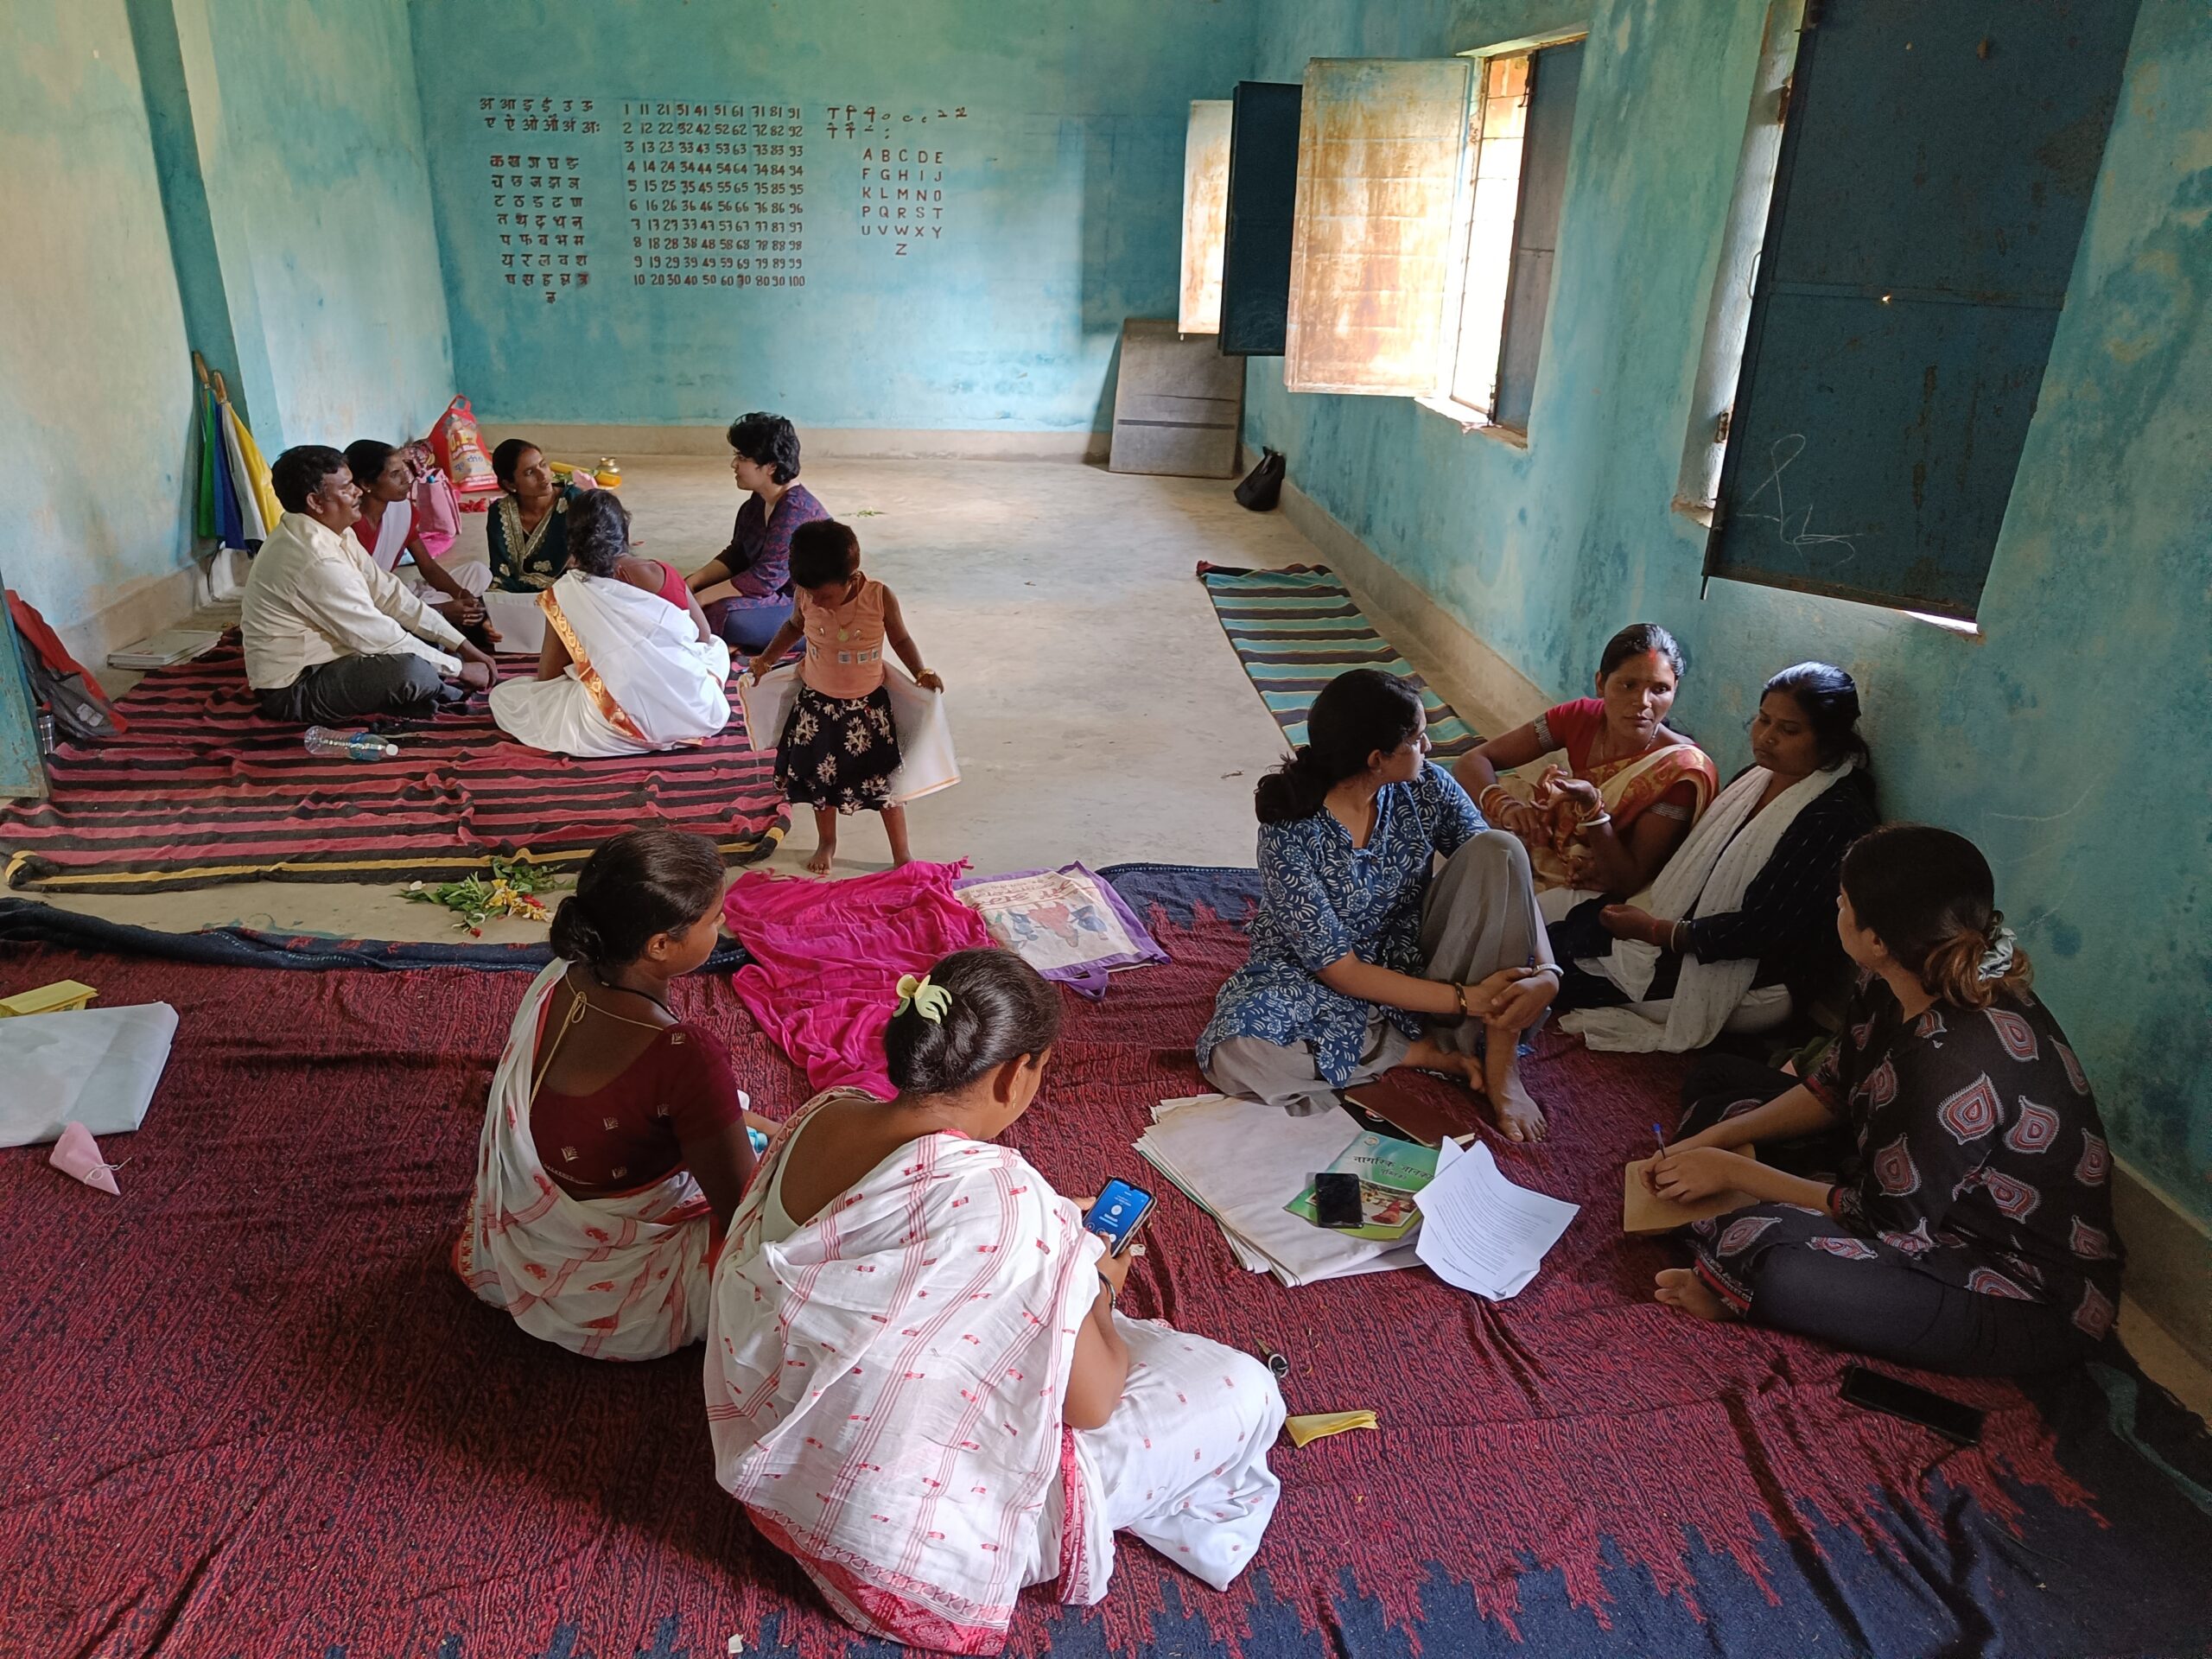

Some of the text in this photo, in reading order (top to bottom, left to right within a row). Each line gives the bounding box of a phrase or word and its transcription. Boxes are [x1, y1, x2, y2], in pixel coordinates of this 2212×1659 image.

[480, 97, 594, 112] अ आ इ ई उ ऊ
[625, 104, 800, 119] 1 11 21 41 51 61 71 81 91
[485, 117, 496, 128] ए
[505, 113, 515, 131] ऐ
[523, 114, 539, 131] ओ
[622, 122, 803, 137] 2 12 22 42 52 62 82 92
[624, 141, 747, 156] 3 13 23 33 43 53 63
[490, 156, 504, 168] क
[508, 156, 521, 168] ख
[528, 156, 540, 168] ग
[547, 157, 559, 169] घ
[862, 148, 944, 164] A B C D E
[626, 161, 785, 175] 4 14 44 54 64 84
[862, 168, 942, 181] F G H I J
[492, 175, 505, 188] च
[531, 176, 543, 188] ज
[627, 180, 748, 194] 5 15 25 45 55 65
[494, 195, 505, 207] ट
[513, 195, 524, 207] ठ
[532, 196, 544, 207] ड
[570, 197, 583, 207] ण
[862, 187, 871, 199] K
[880, 188, 888, 199] L
[898, 188, 908, 200] M
[916, 190, 927, 201] N
[629, 199, 803, 214] 6 16 26 36 46 56 66 86 96
[862, 206, 944, 219] P Q R S T
[497, 213, 508, 225] त
[515, 213, 529, 227] थ
[536, 215, 546, 230] द
[571, 216, 583, 229] न
[631, 219, 803, 233] 7 17 27 37 47 57 67 77 87 97
[861, 226, 942, 238] U V W X Y
[499, 234, 585, 246] प फ ब भ म
[633, 236, 750, 250] 8 18 48 58 68
[895, 244, 907, 256] Z
[501, 254, 588, 268] य र ल व श
[634, 256, 785, 270] 9 19 29 39 49 59 69 79 89
[522, 274, 535, 286] स
[542, 274, 553, 286] ह
[634, 274, 805, 287] 10 20 40 50 60 80 100
[1402, 1164, 1434, 1179] जानका
